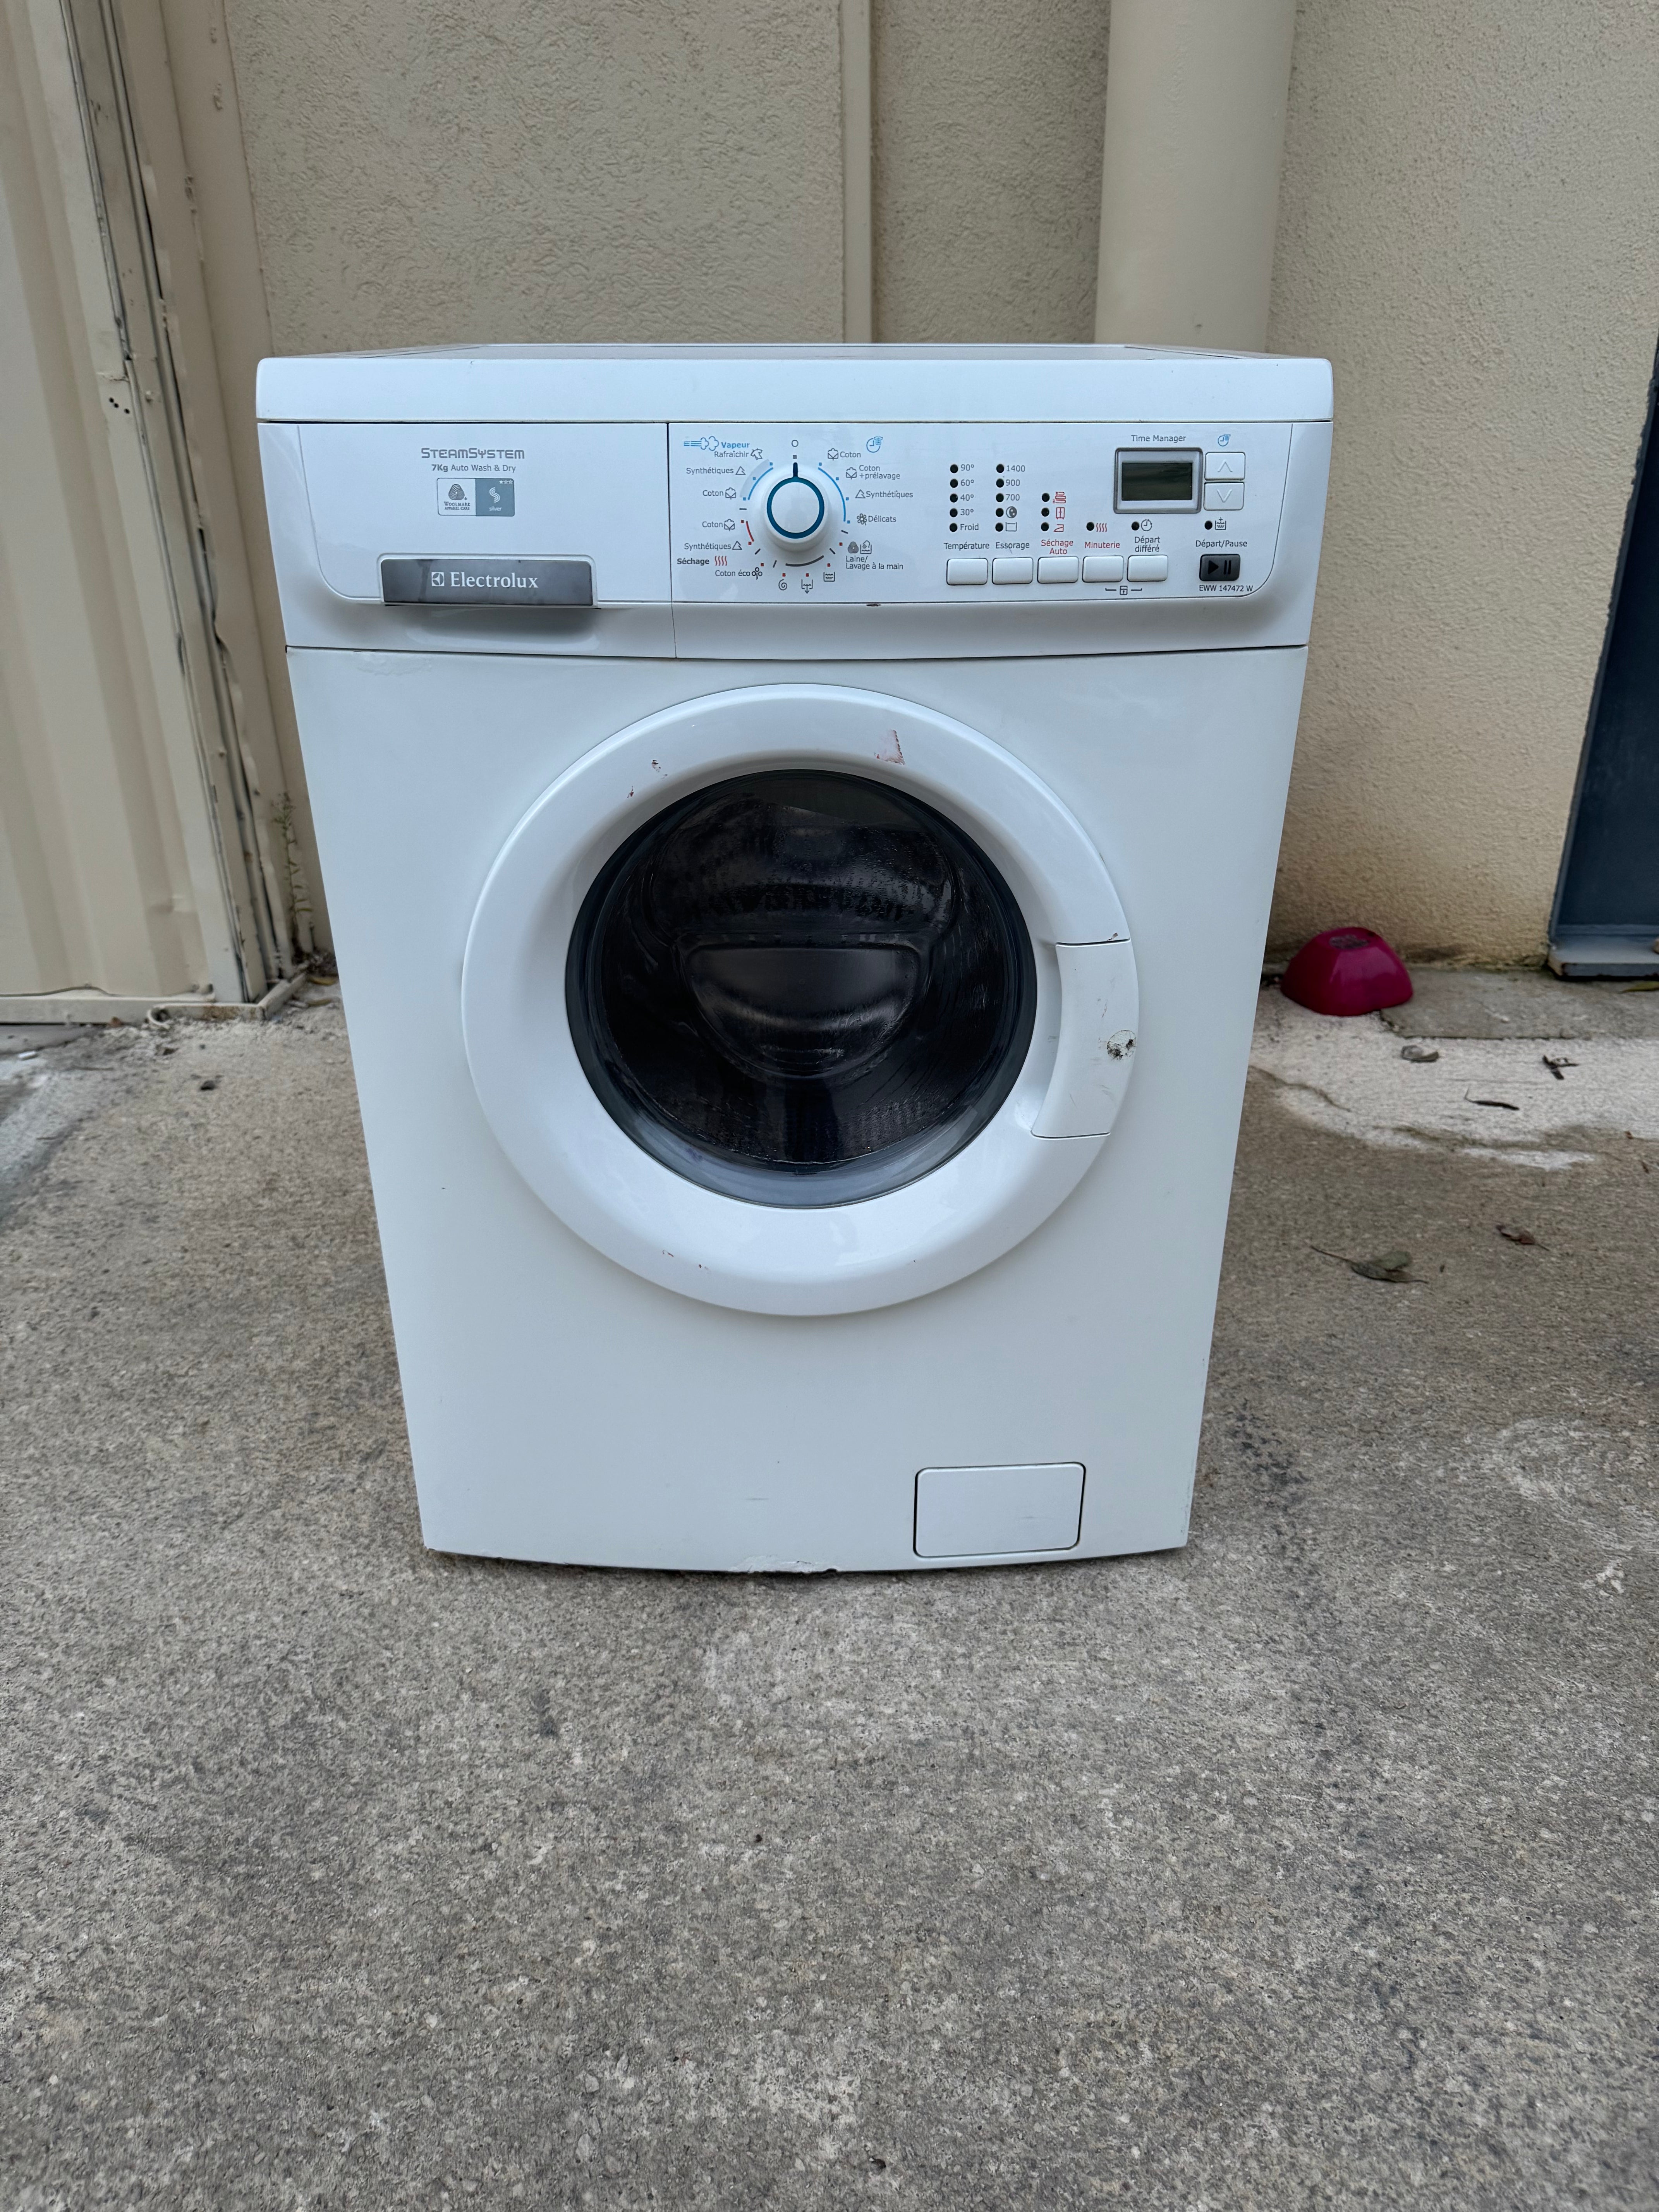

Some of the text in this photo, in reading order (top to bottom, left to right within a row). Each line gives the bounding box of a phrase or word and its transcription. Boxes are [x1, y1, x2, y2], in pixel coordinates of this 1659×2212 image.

[1153, 435, 1187, 443] Manager
[502, 465, 516, 473] Dry
[686, 467, 734, 475] Synthétiques
[859, 472, 900, 480] +prélavage
[866, 490, 913, 499] Synthétiques
[1041, 539, 1073, 548] Séchage
[1134, 535, 1161, 544] Départ
[684, 543, 731, 551] Synthétiques
[944, 541, 990, 551] Température
[996, 542, 1030, 550] Essorage
[1134, 544, 1160, 552] différé
[1195, 539, 1248, 549] Départ/Pause
[450, 572, 539, 588] Electrolux
